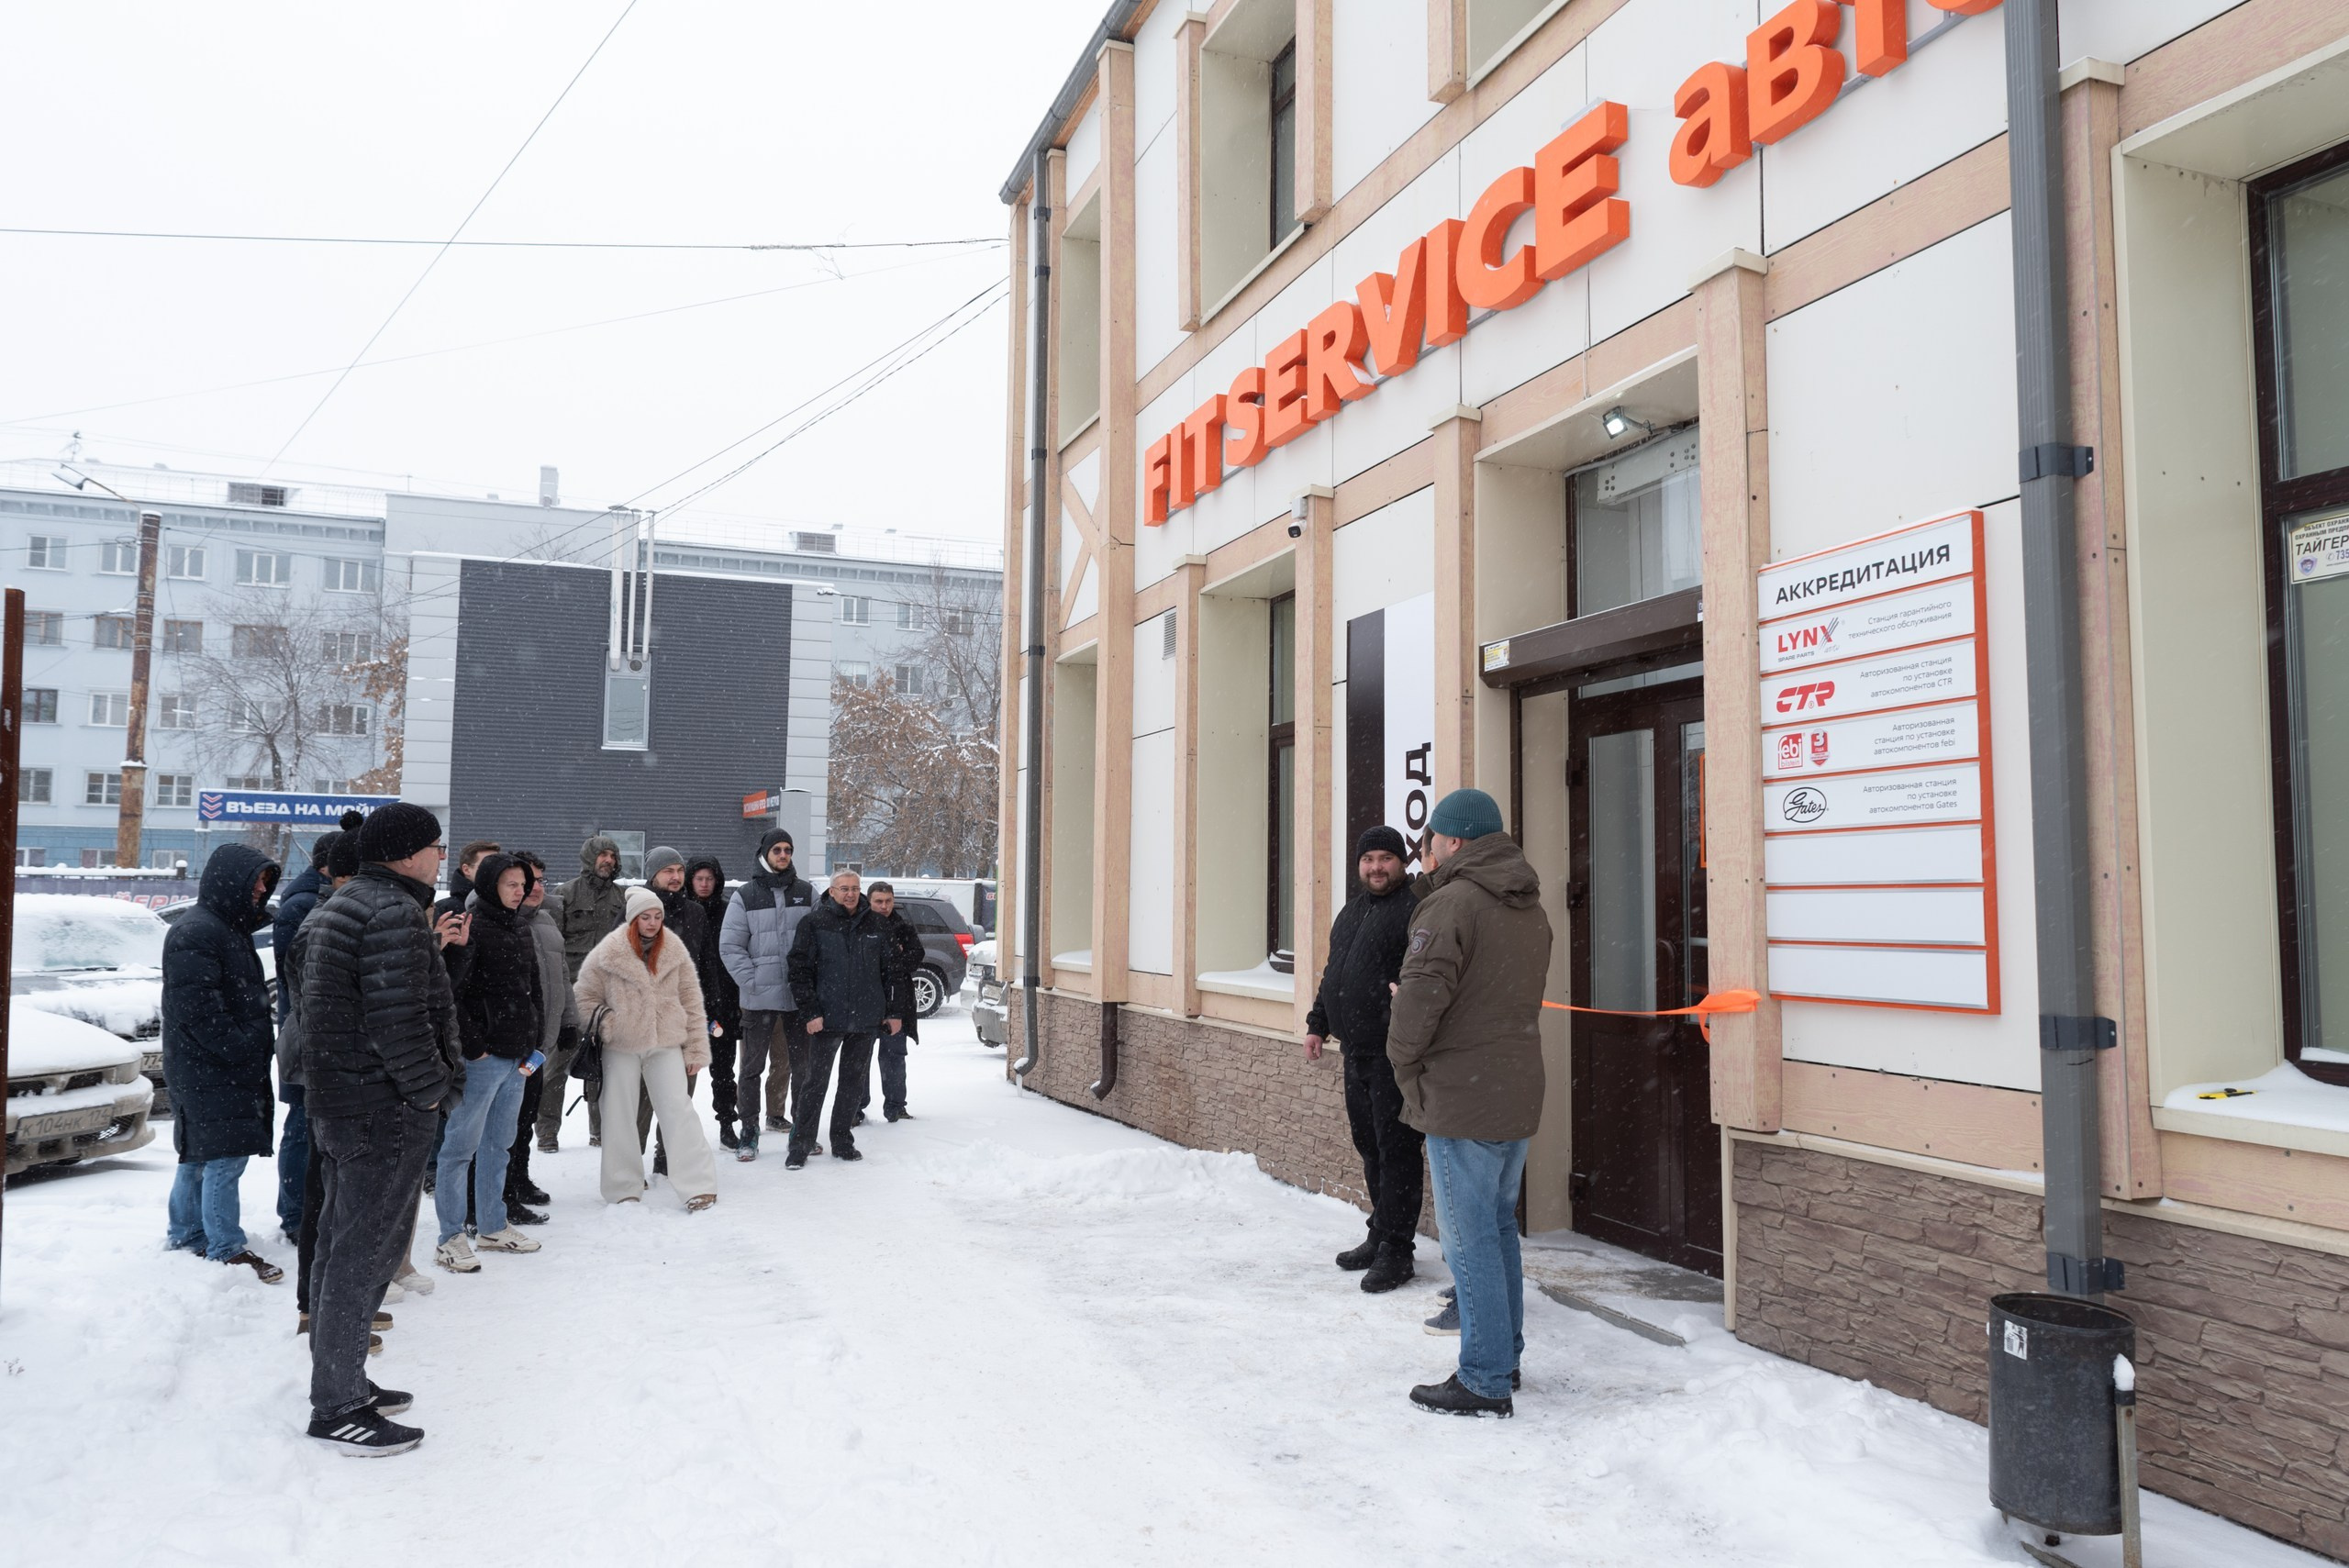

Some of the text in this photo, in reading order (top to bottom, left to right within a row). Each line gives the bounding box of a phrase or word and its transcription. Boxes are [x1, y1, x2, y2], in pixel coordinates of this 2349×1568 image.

[2295, 529, 2327, 540] ОХРАННЫМ
[2304, 522, 2325, 532] ОБЪЕКТ
[2296, 535, 2349, 556] ТАЙГЕР
[1776, 544, 1950, 605] АККРЕДИТАЦИЯ
[1867, 601, 1952, 625] Станция гарантийного
[1848, 612, 1952, 639] технического обслуживания
[1777, 620, 1838, 653] LYNX
[1777, 651, 1815, 662] SPARE PARTS
[1860, 657, 1952, 679] Авторизованная станция
[1913, 667, 1953, 682] установке
[1870, 677, 1953, 698] автокомпонентов CTR
[1892, 717, 1955, 731] Авторизованная
[1813, 729, 1825, 747] 3
[1874, 735, 1904, 745] станция
[1916, 728, 1955, 741] установке
[1778, 734, 1802, 760] febi
[1874, 738, 1955, 755] автокомпонентов febi
[1863, 778, 1957, 794] Авторизованная станция
[1918, 790, 1957, 801] установке
[226, 801, 291, 815] ВЪЕЗД
[295, 804, 321, 816] НА
[1406, 741, 1431, 881] ХОД
[1784, 791, 1825, 820] Gates
[1869, 801, 1957, 814] автокомпонентов Gates
